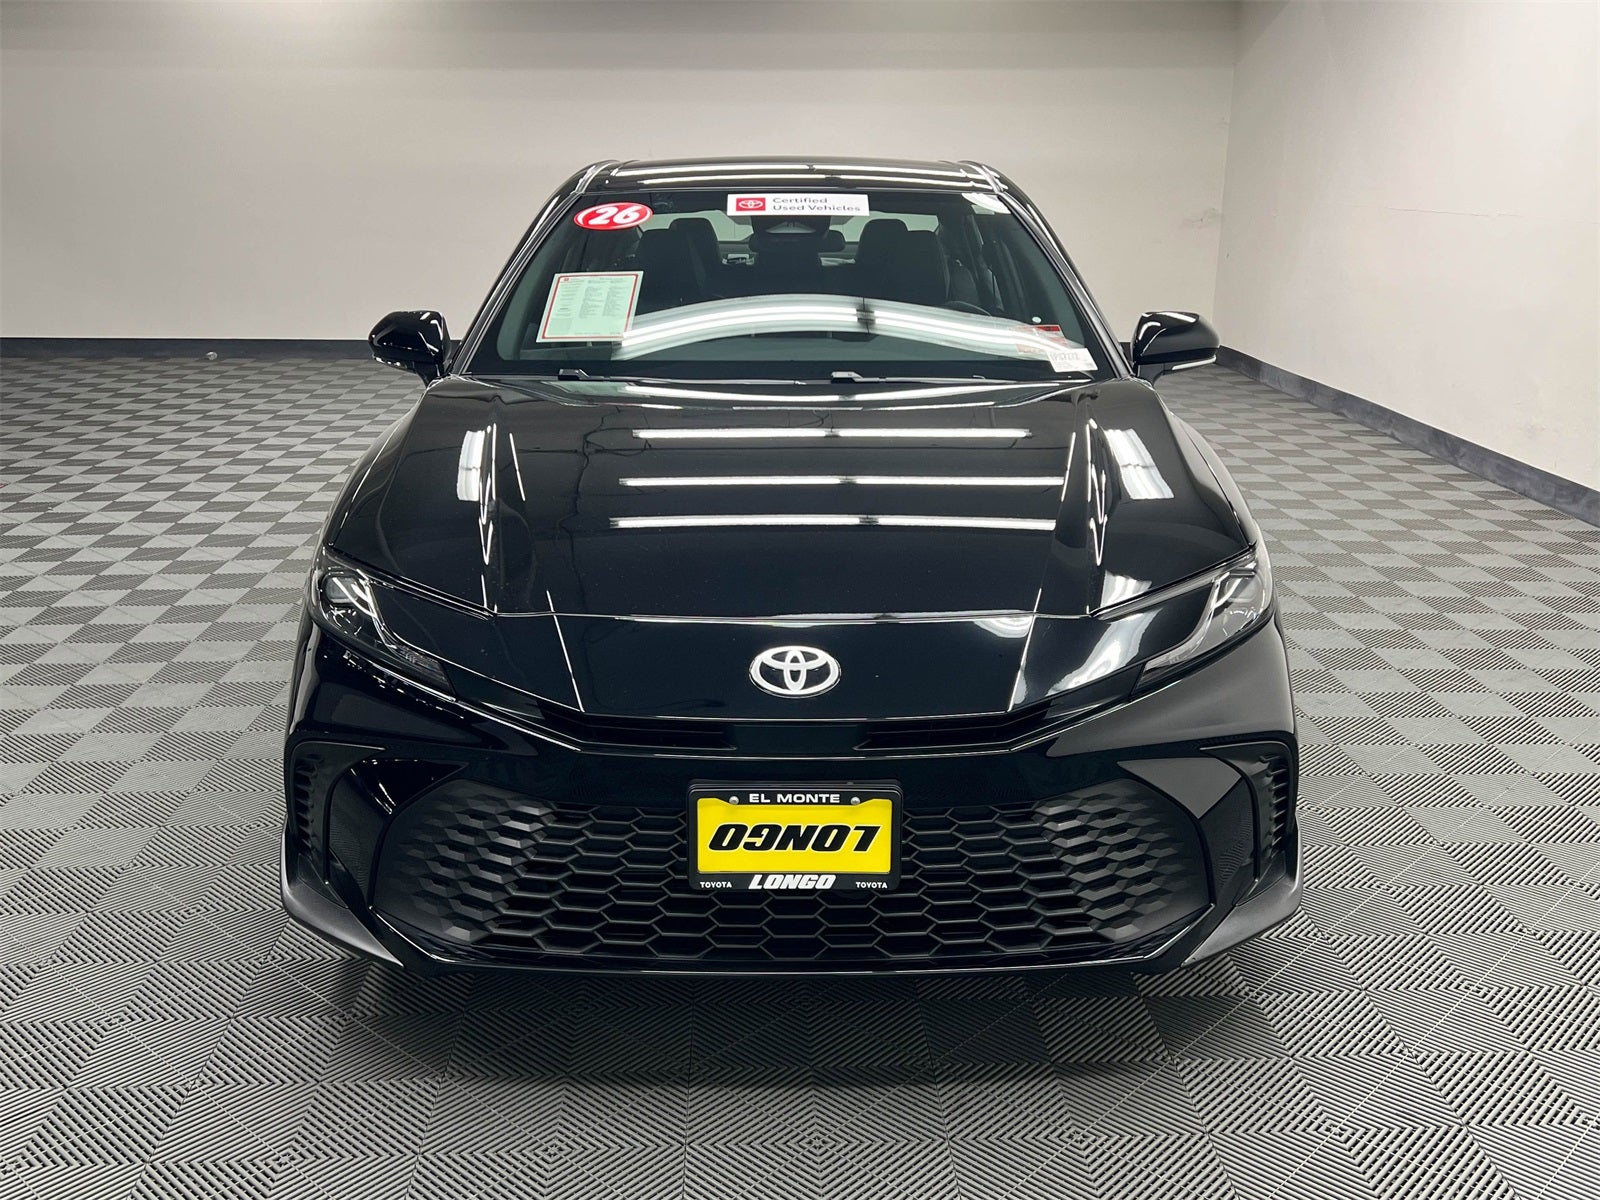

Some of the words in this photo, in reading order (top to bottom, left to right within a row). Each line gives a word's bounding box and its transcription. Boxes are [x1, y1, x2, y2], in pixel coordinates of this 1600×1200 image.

[807, 204, 861, 212] Vehicles
[587, 205, 640, 225] 26
[749, 793, 770, 803] EL
[776, 793, 840, 803] MONTE
[708, 823, 881, 852] LONGO
[700, 881, 732, 889] TOYOTA
[748, 874, 836, 890] LONGO
[855, 881, 888, 889] TOYOTA
